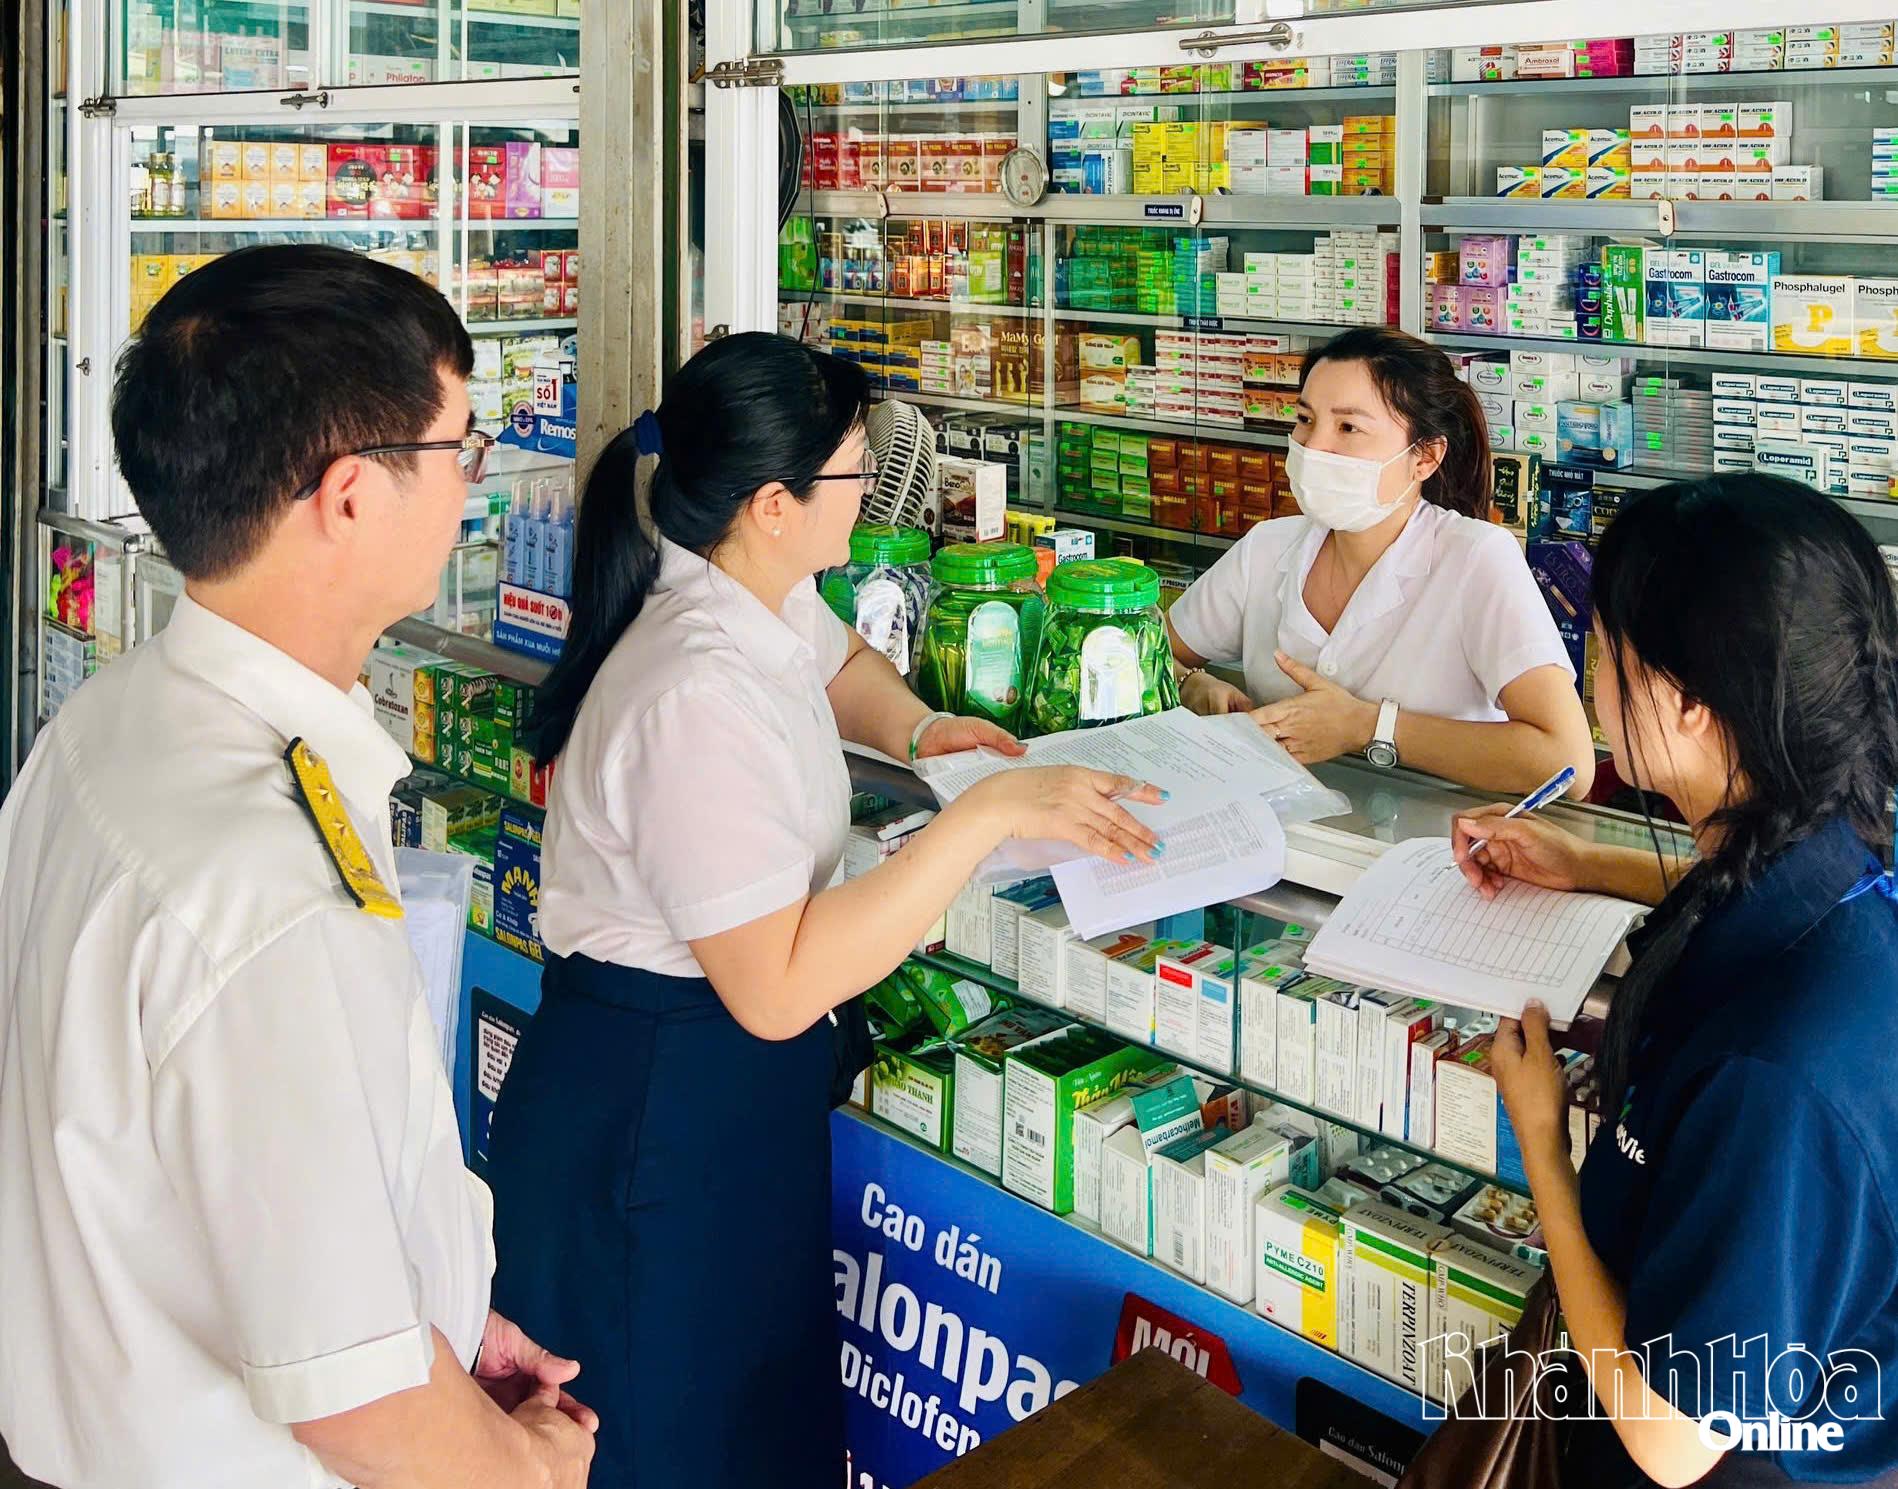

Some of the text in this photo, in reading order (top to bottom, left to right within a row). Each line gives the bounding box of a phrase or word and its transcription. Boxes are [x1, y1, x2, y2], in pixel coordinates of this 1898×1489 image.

[1524, 57, 1560, 65] Ambroxol
[1648, 267, 1692, 279] Gastrocom
[1708, 269, 1755, 281] Gastrocom
[1774, 281, 1846, 294] Phosphalugel
[1001, 331, 1029, 346] MaMy
[536, 385, 551, 400] SỐ
[540, 418, 577, 440] Remos
[1762, 452, 1812, 466] Loperamid
[1058, 552, 1088, 564] Gastrocom
[528, 939, 545, 961] GEL
[1358, 1208, 1427, 1240] TERPINZOAT
[861, 1182, 1003, 1295] Cao dán
[1450, 1241, 1527, 1278] TERPINZOAT
[1402, 1281, 1416, 1387] TERPINZOAT
